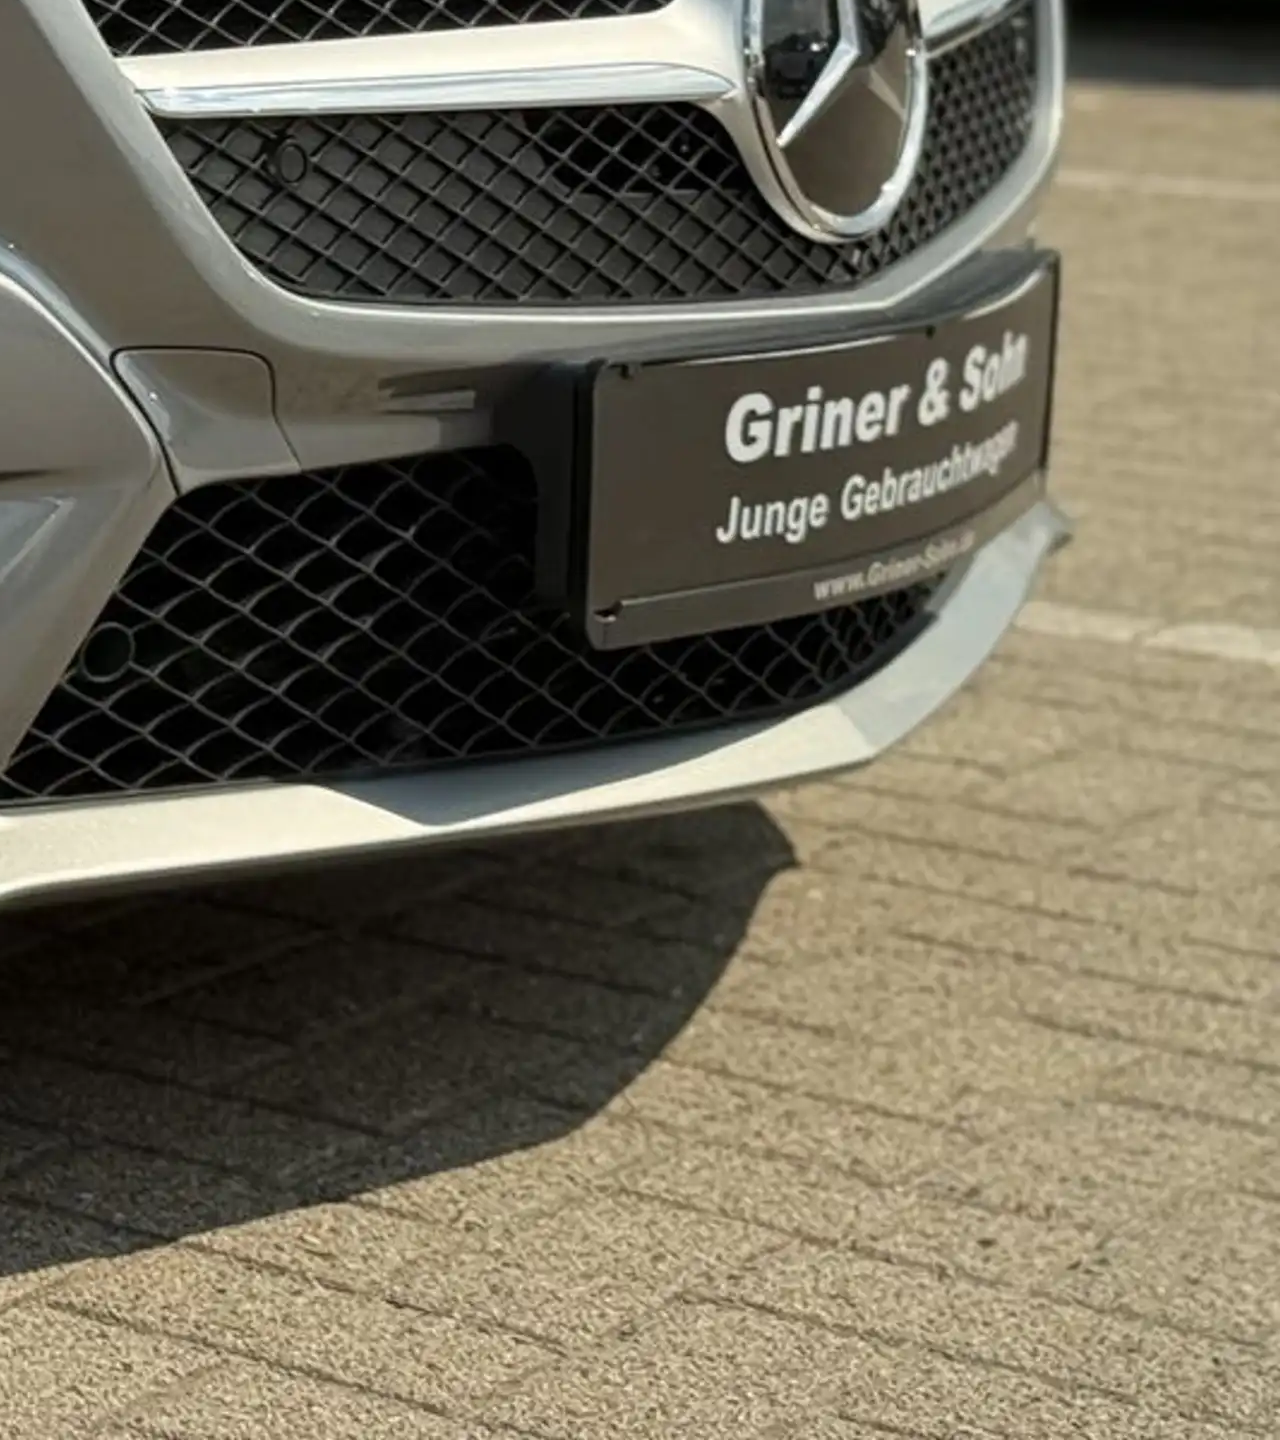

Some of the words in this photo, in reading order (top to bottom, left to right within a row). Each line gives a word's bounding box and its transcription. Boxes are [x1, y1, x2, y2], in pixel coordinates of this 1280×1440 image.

[725, 384, 911, 463] Griner
[917, 357, 951, 427] &
[959, 329, 1028, 412] Sohn
[716, 493, 828, 543] Junge
